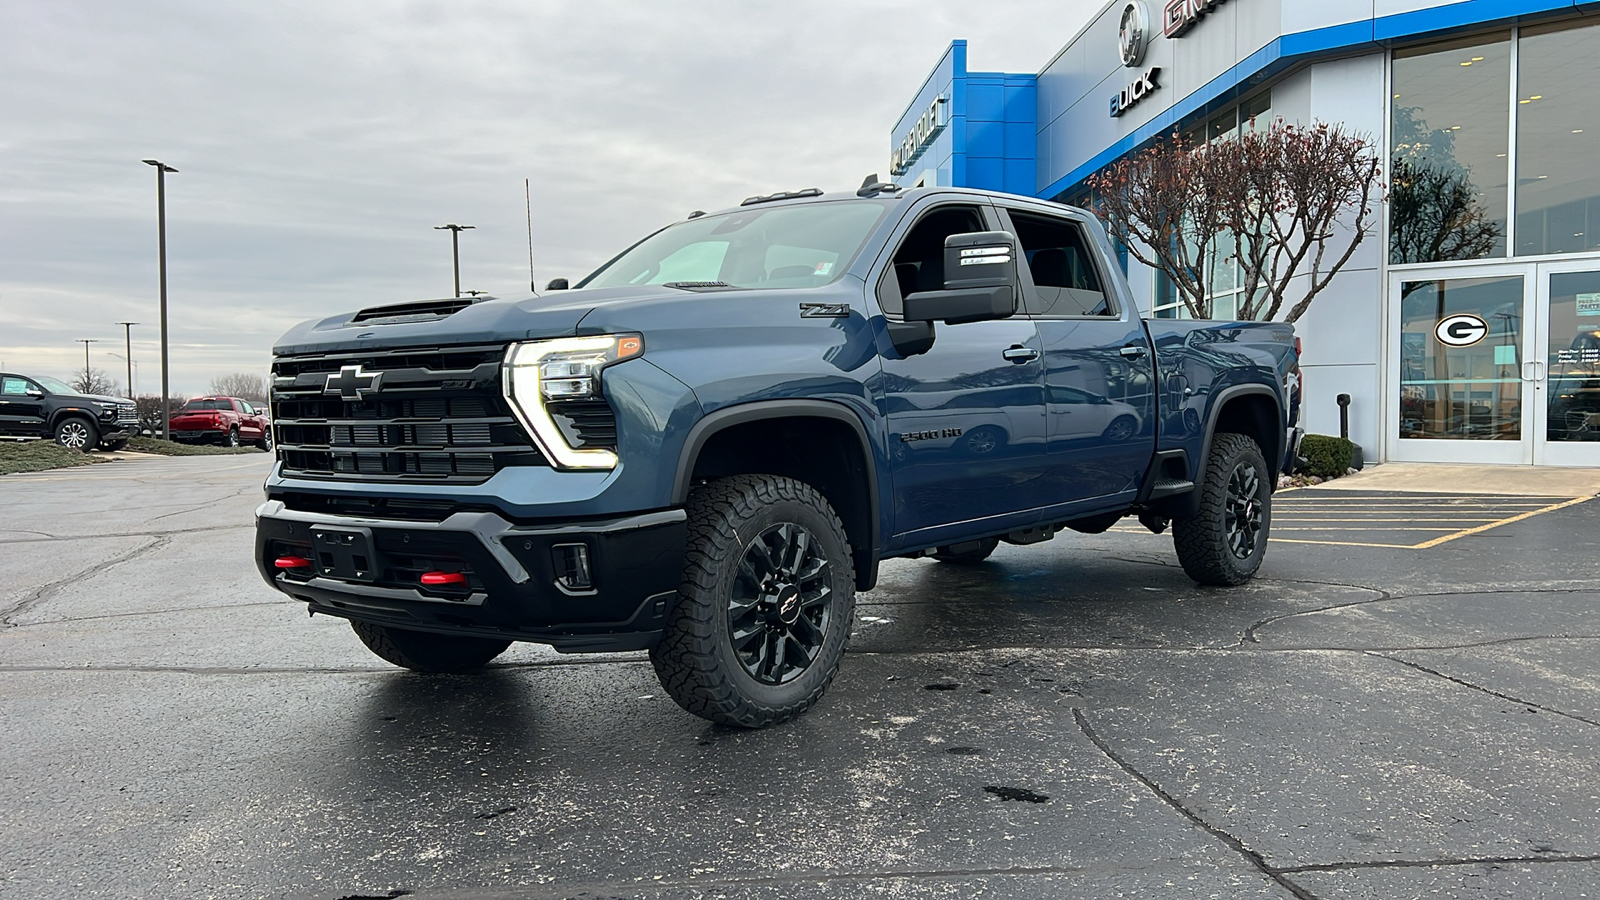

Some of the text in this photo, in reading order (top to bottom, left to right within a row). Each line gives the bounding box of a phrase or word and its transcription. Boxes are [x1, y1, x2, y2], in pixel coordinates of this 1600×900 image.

[1109, 66, 1160, 117] BUICK
[901, 93, 947, 168] CHEVROLET
[1436, 316, 1486, 345] G
